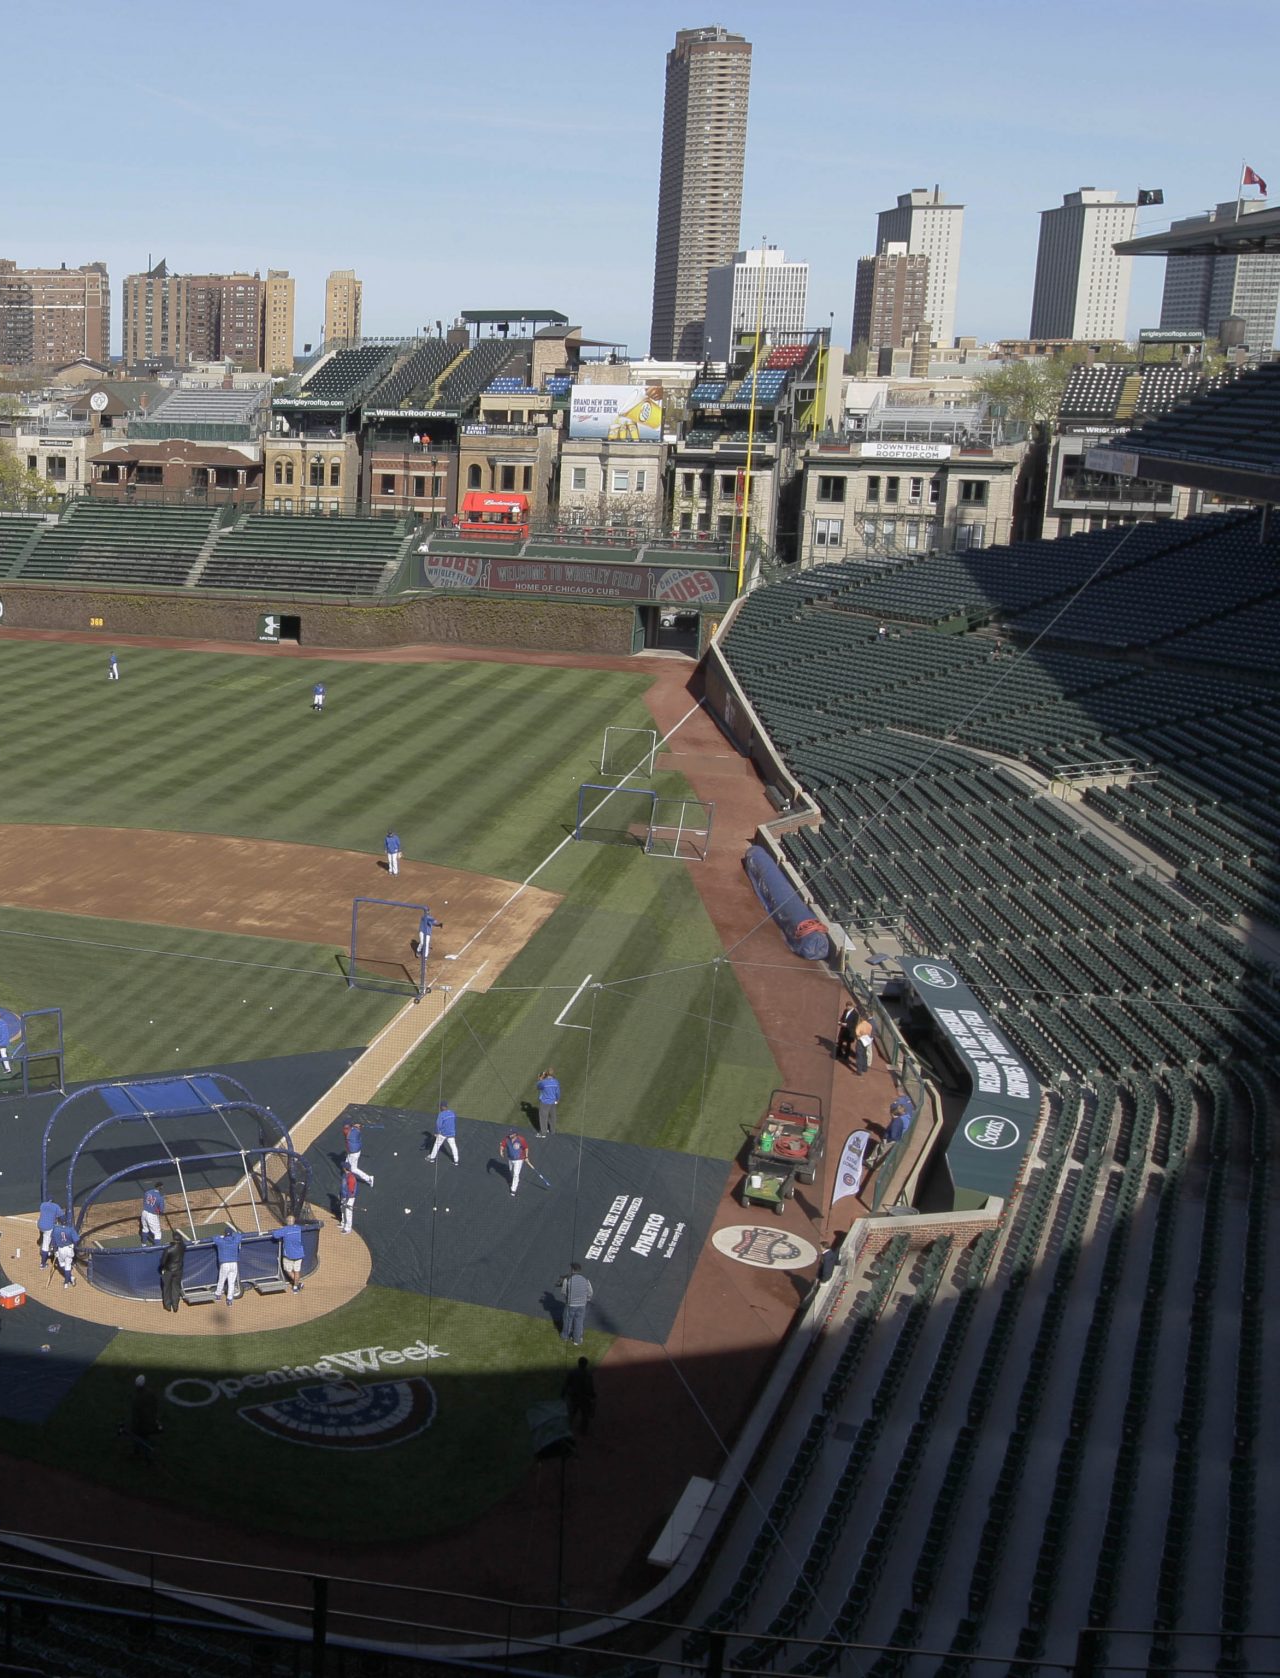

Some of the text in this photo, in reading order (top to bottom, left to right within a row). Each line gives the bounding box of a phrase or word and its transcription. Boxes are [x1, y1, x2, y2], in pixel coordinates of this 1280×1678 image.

[364, 409, 458, 418] www.WRIGLEYROOFTOPS.com
[876, 450, 939, 459] ROOFTOP.COM
[428, 567, 474, 586] WRIGLEY FIELD
[497, 564, 642, 591] WELCOME TO WRIGLEY FIELD
[659, 570, 693, 589] CHICAG
[515, 583, 620, 596] HOME OF CHICAGO CUBS
[90, 617, 103, 626] 368
[973, 1059, 1001, 1094] WELCOME
[976, 1119, 1006, 1146] Scotts
[585, 1245, 603, 1260] THE
[602, 1213, 619, 1227] THE
[617, 1219, 632, 1236] THEM
[630, 1213, 665, 1257] ATHLETICO
[612, 1235, 625, 1247] GOT
[165, 1339, 450, 1408] Opening Week
